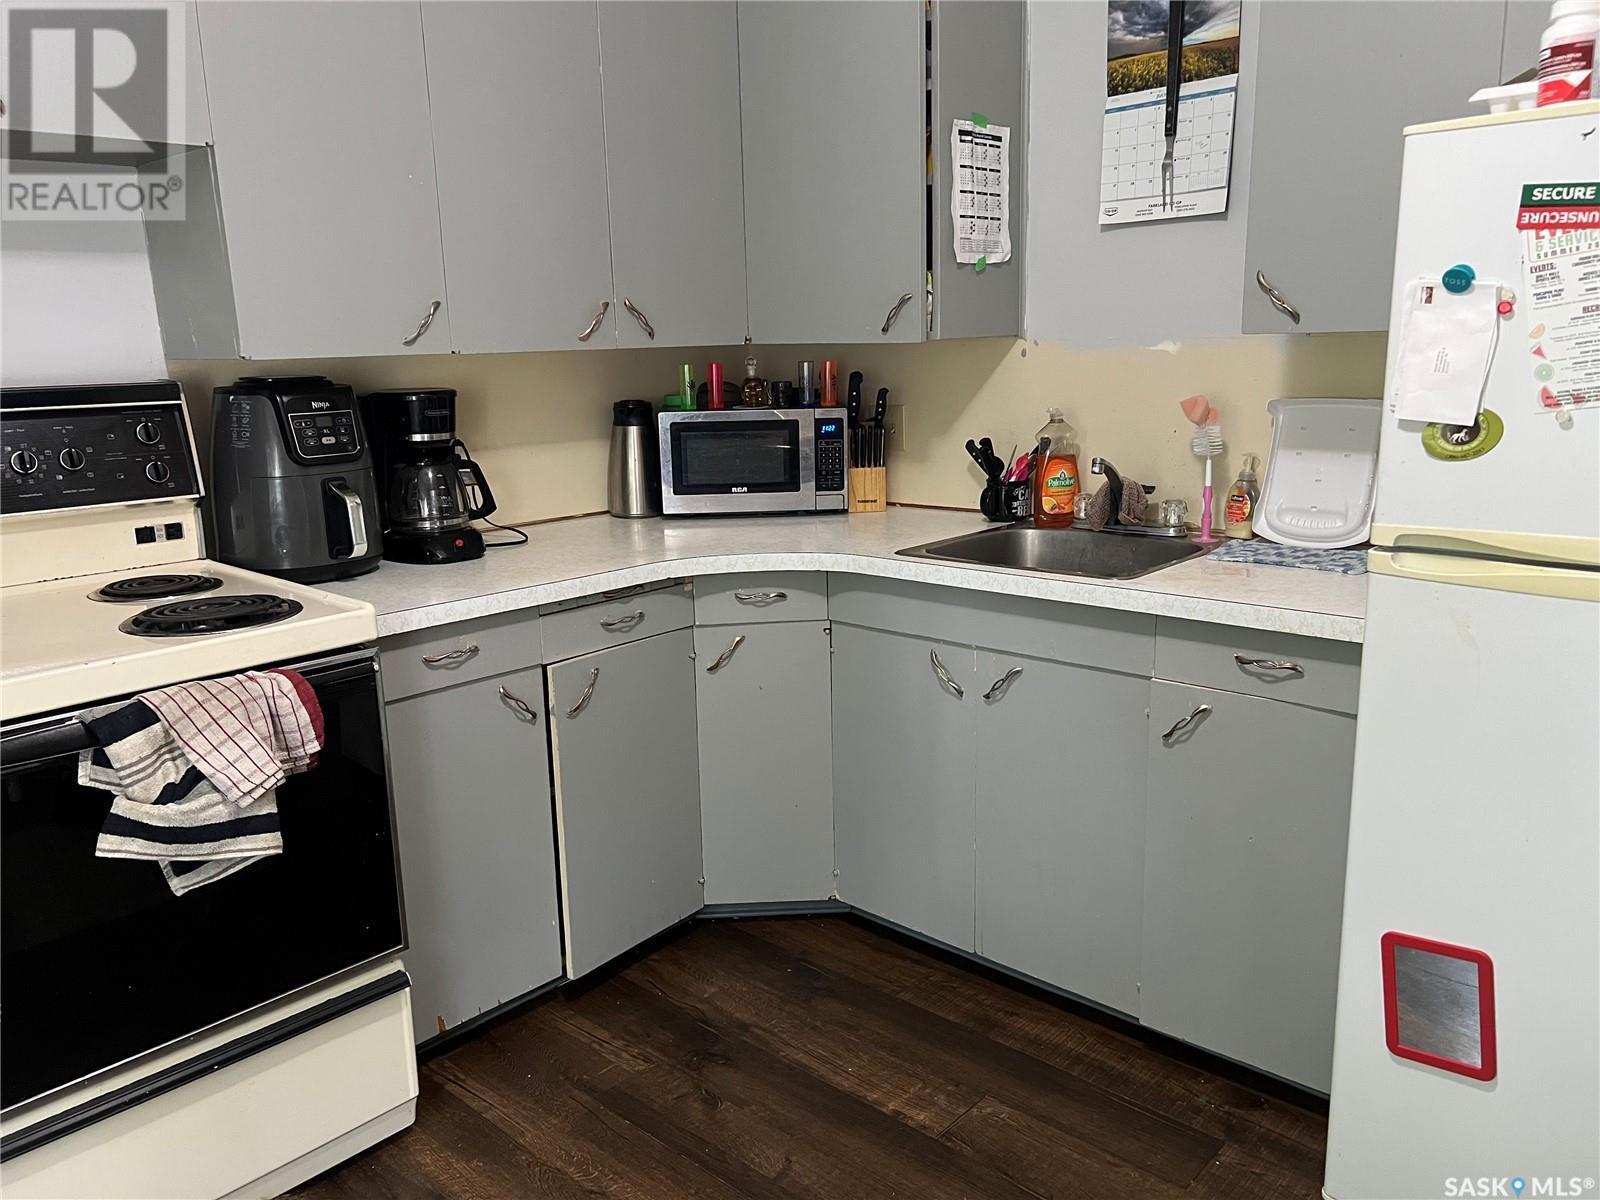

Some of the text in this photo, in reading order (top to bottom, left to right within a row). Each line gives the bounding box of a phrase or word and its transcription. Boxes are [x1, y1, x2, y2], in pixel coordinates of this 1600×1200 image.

[1531, 186, 1597, 201] SECURE
[1521, 211, 1599, 224] UNSECURE
[1548, 230, 1600, 250] SERVIC
[1536, 245, 1580, 260] SUMMER
[1047, 478, 1075, 487] Palmolive
